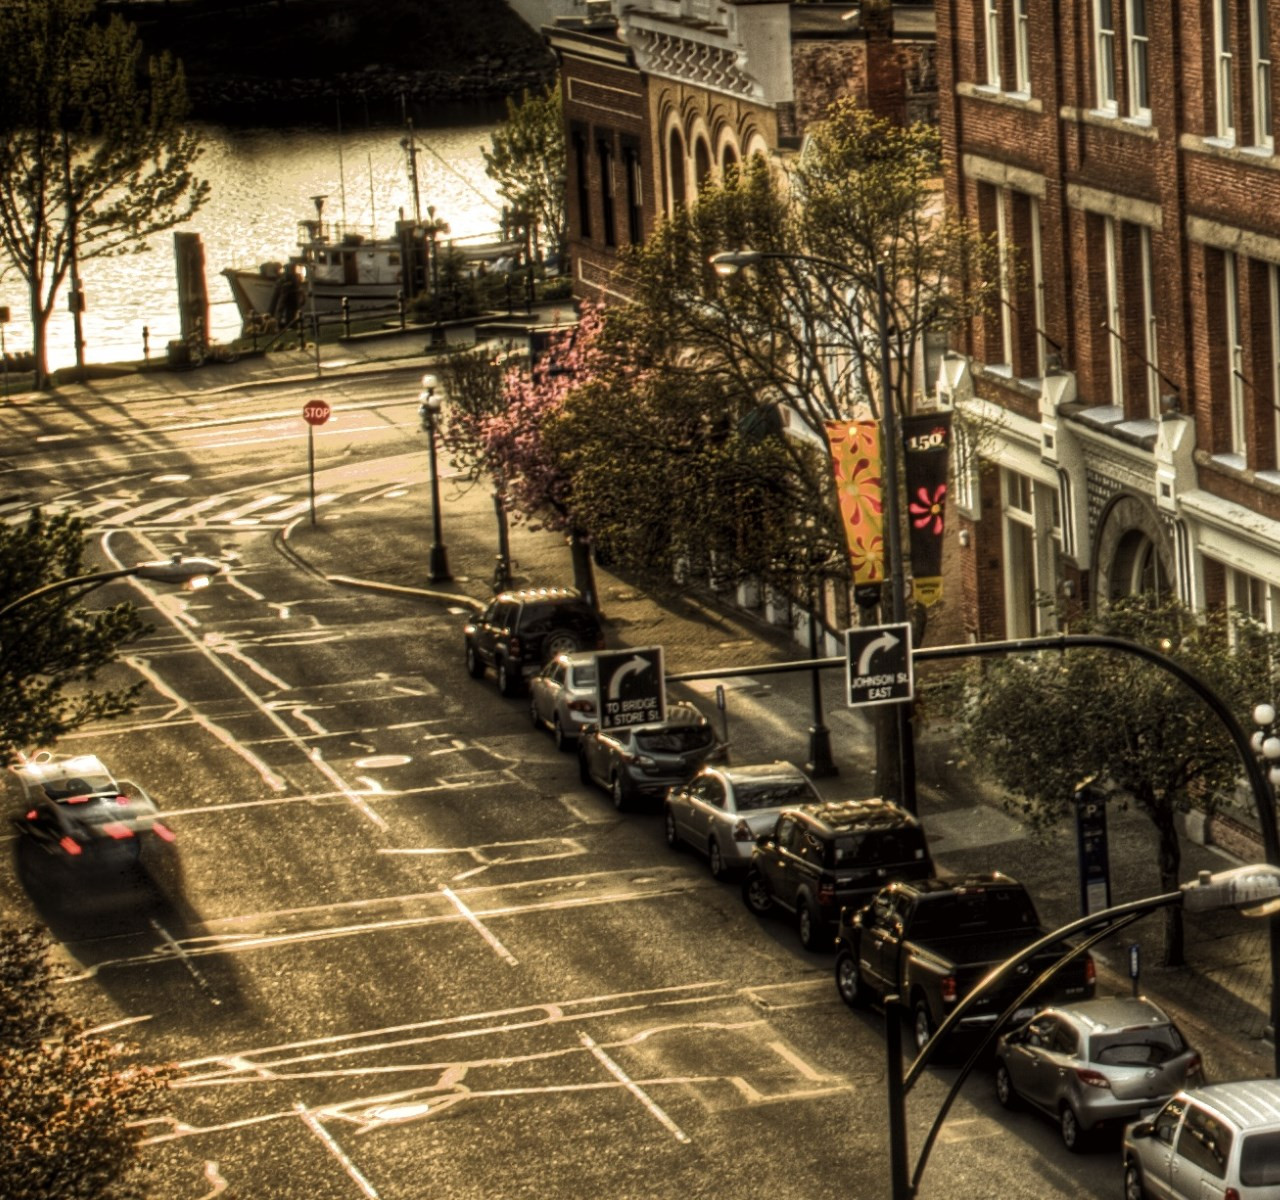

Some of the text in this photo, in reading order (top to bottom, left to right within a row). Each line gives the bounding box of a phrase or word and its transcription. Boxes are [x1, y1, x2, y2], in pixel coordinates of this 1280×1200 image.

[304, 407, 330, 418] STOP
[911, 433, 942, 450] 150
[852, 673, 895, 689] JOHNSON
[868, 686, 892, 700] EAST
[606, 697, 657, 714] TO BRIDGE
[614, 711, 645, 726] STORE
